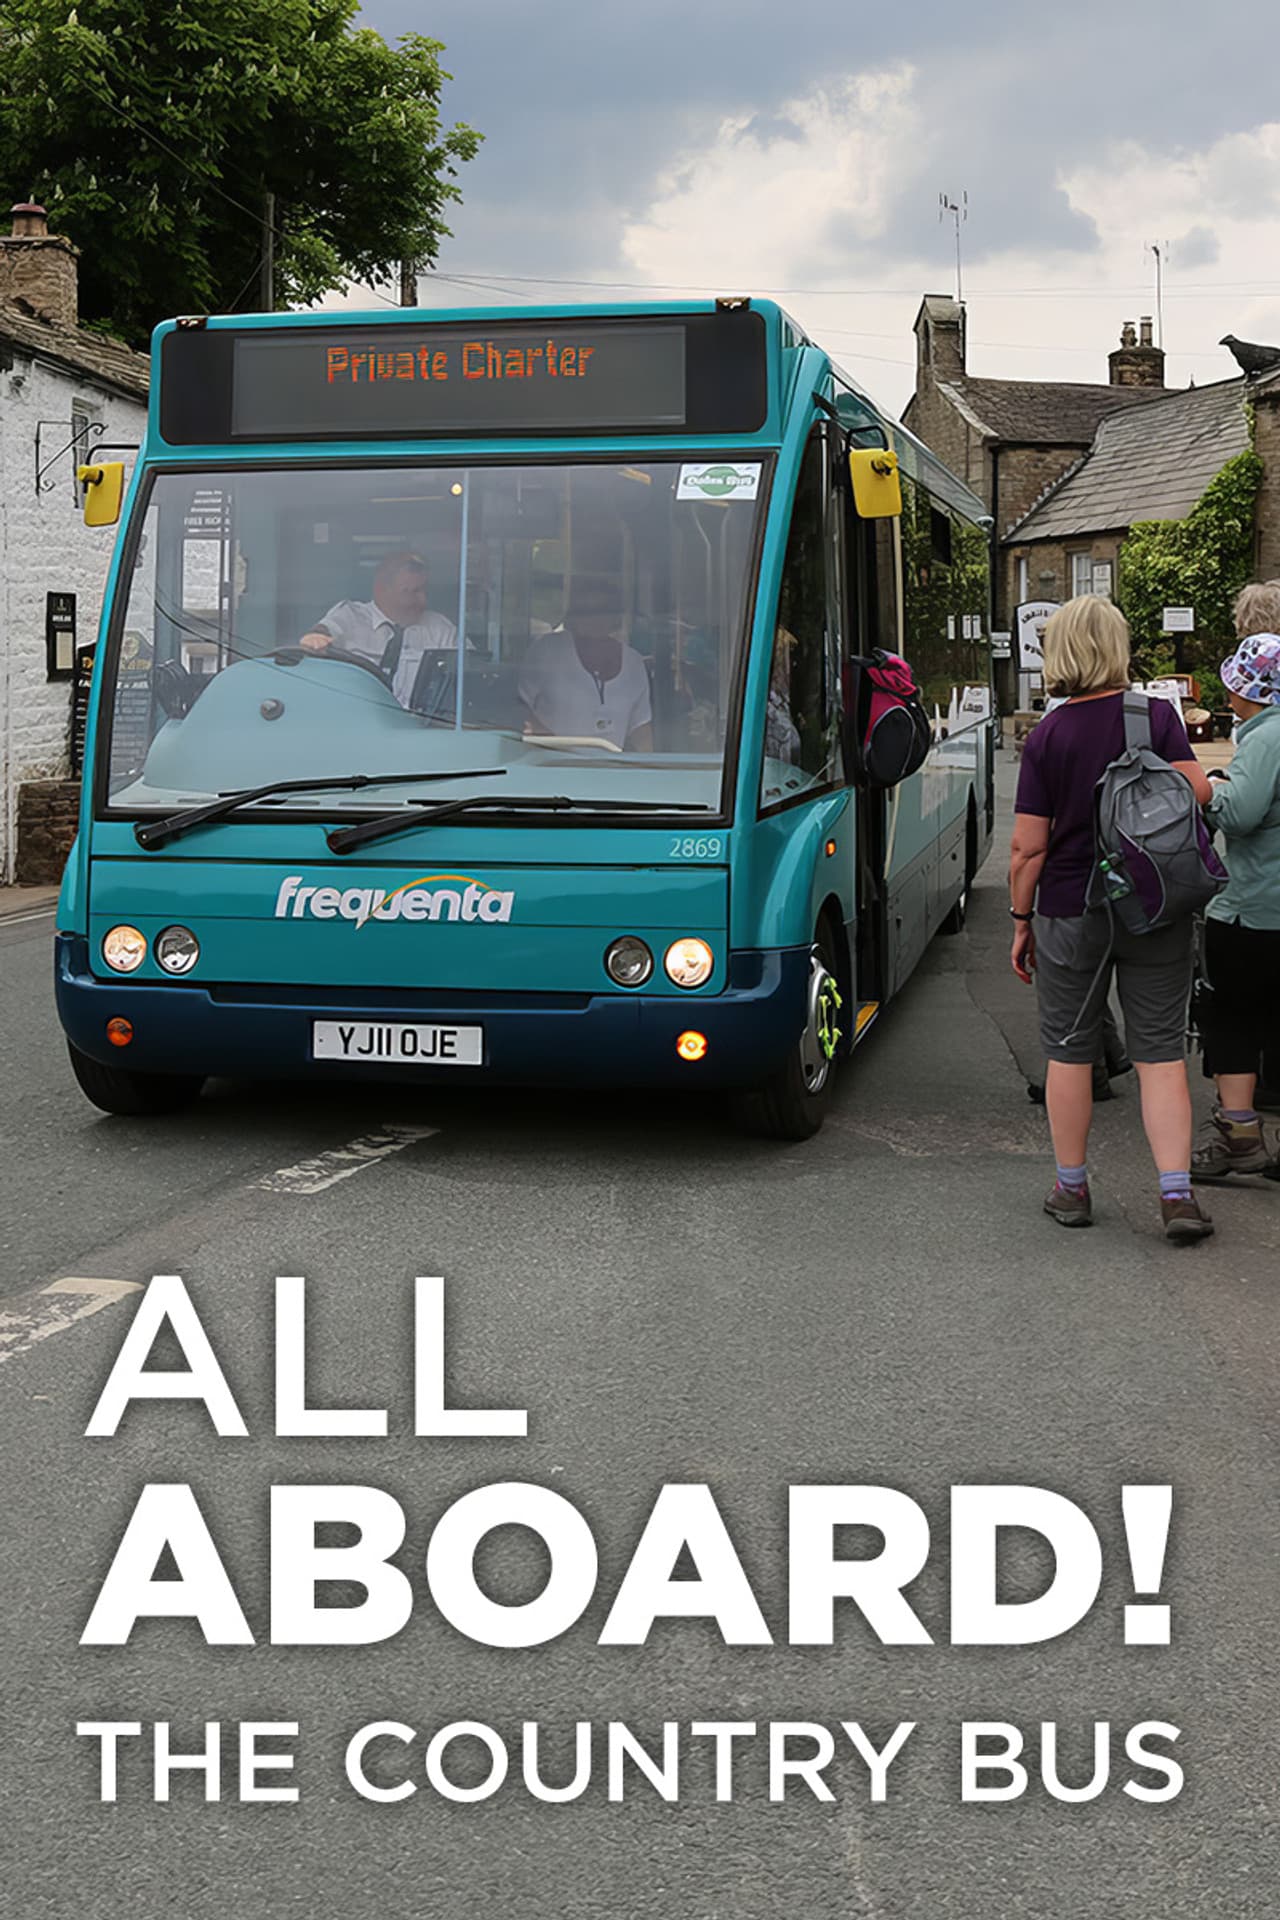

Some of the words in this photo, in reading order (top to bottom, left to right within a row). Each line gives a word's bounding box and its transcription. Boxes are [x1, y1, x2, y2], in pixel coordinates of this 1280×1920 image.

[327, 345, 448, 383] Private
[462, 340, 596, 379] Charter
[669, 838, 721, 858] 2869
[275, 876, 515, 930] frequenta
[400, 1028, 458, 1059] OJE
